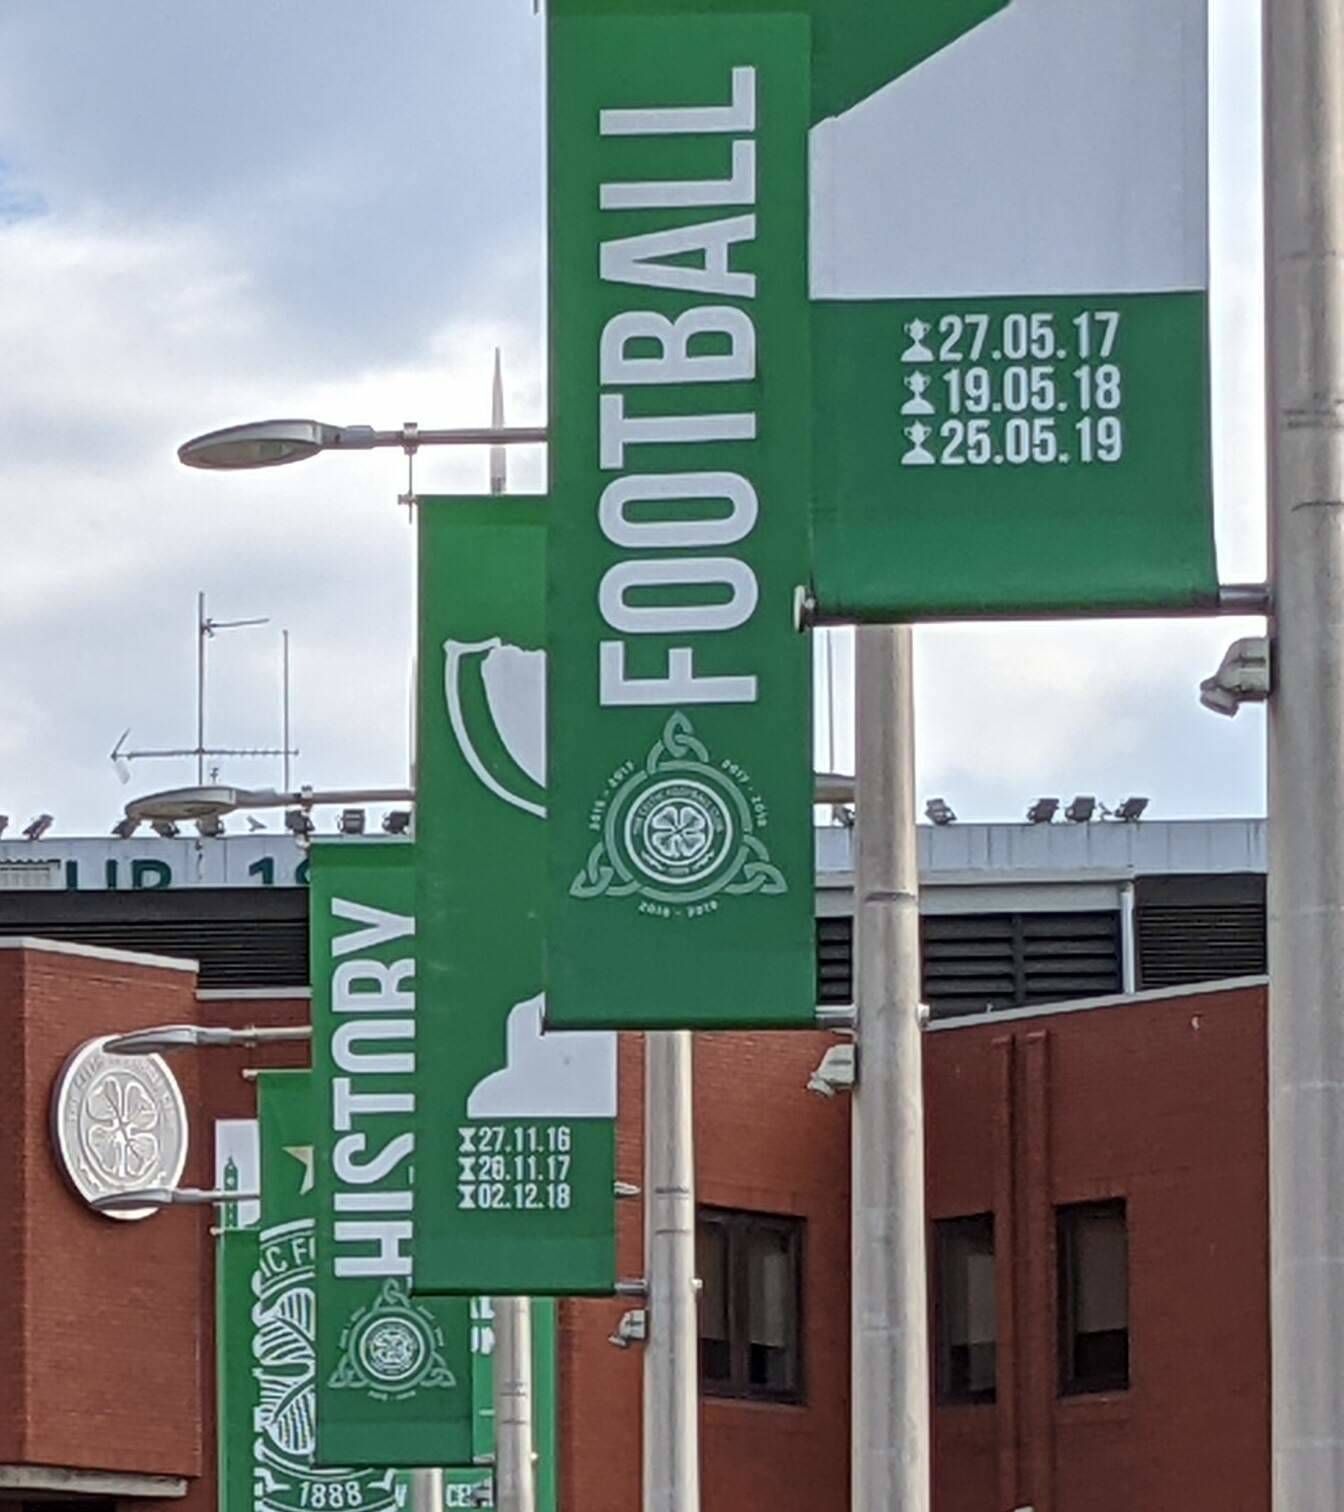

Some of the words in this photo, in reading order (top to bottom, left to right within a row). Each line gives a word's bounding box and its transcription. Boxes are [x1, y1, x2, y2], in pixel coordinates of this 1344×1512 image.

[938, 311, 1120, 362] 27.05.17
[598, 66, 758, 706] FOOTBALL
[942, 364, 1121, 414] 19.05.18
[939, 416, 1122, 465] 25.05.19
[331, 897, 416, 1278] HISTORY
[478, 1126, 571, 1153] 27.11.16
[477, 1182, 571, 1209] 02.12.18
[299, 1481, 363, 1508] 1888
